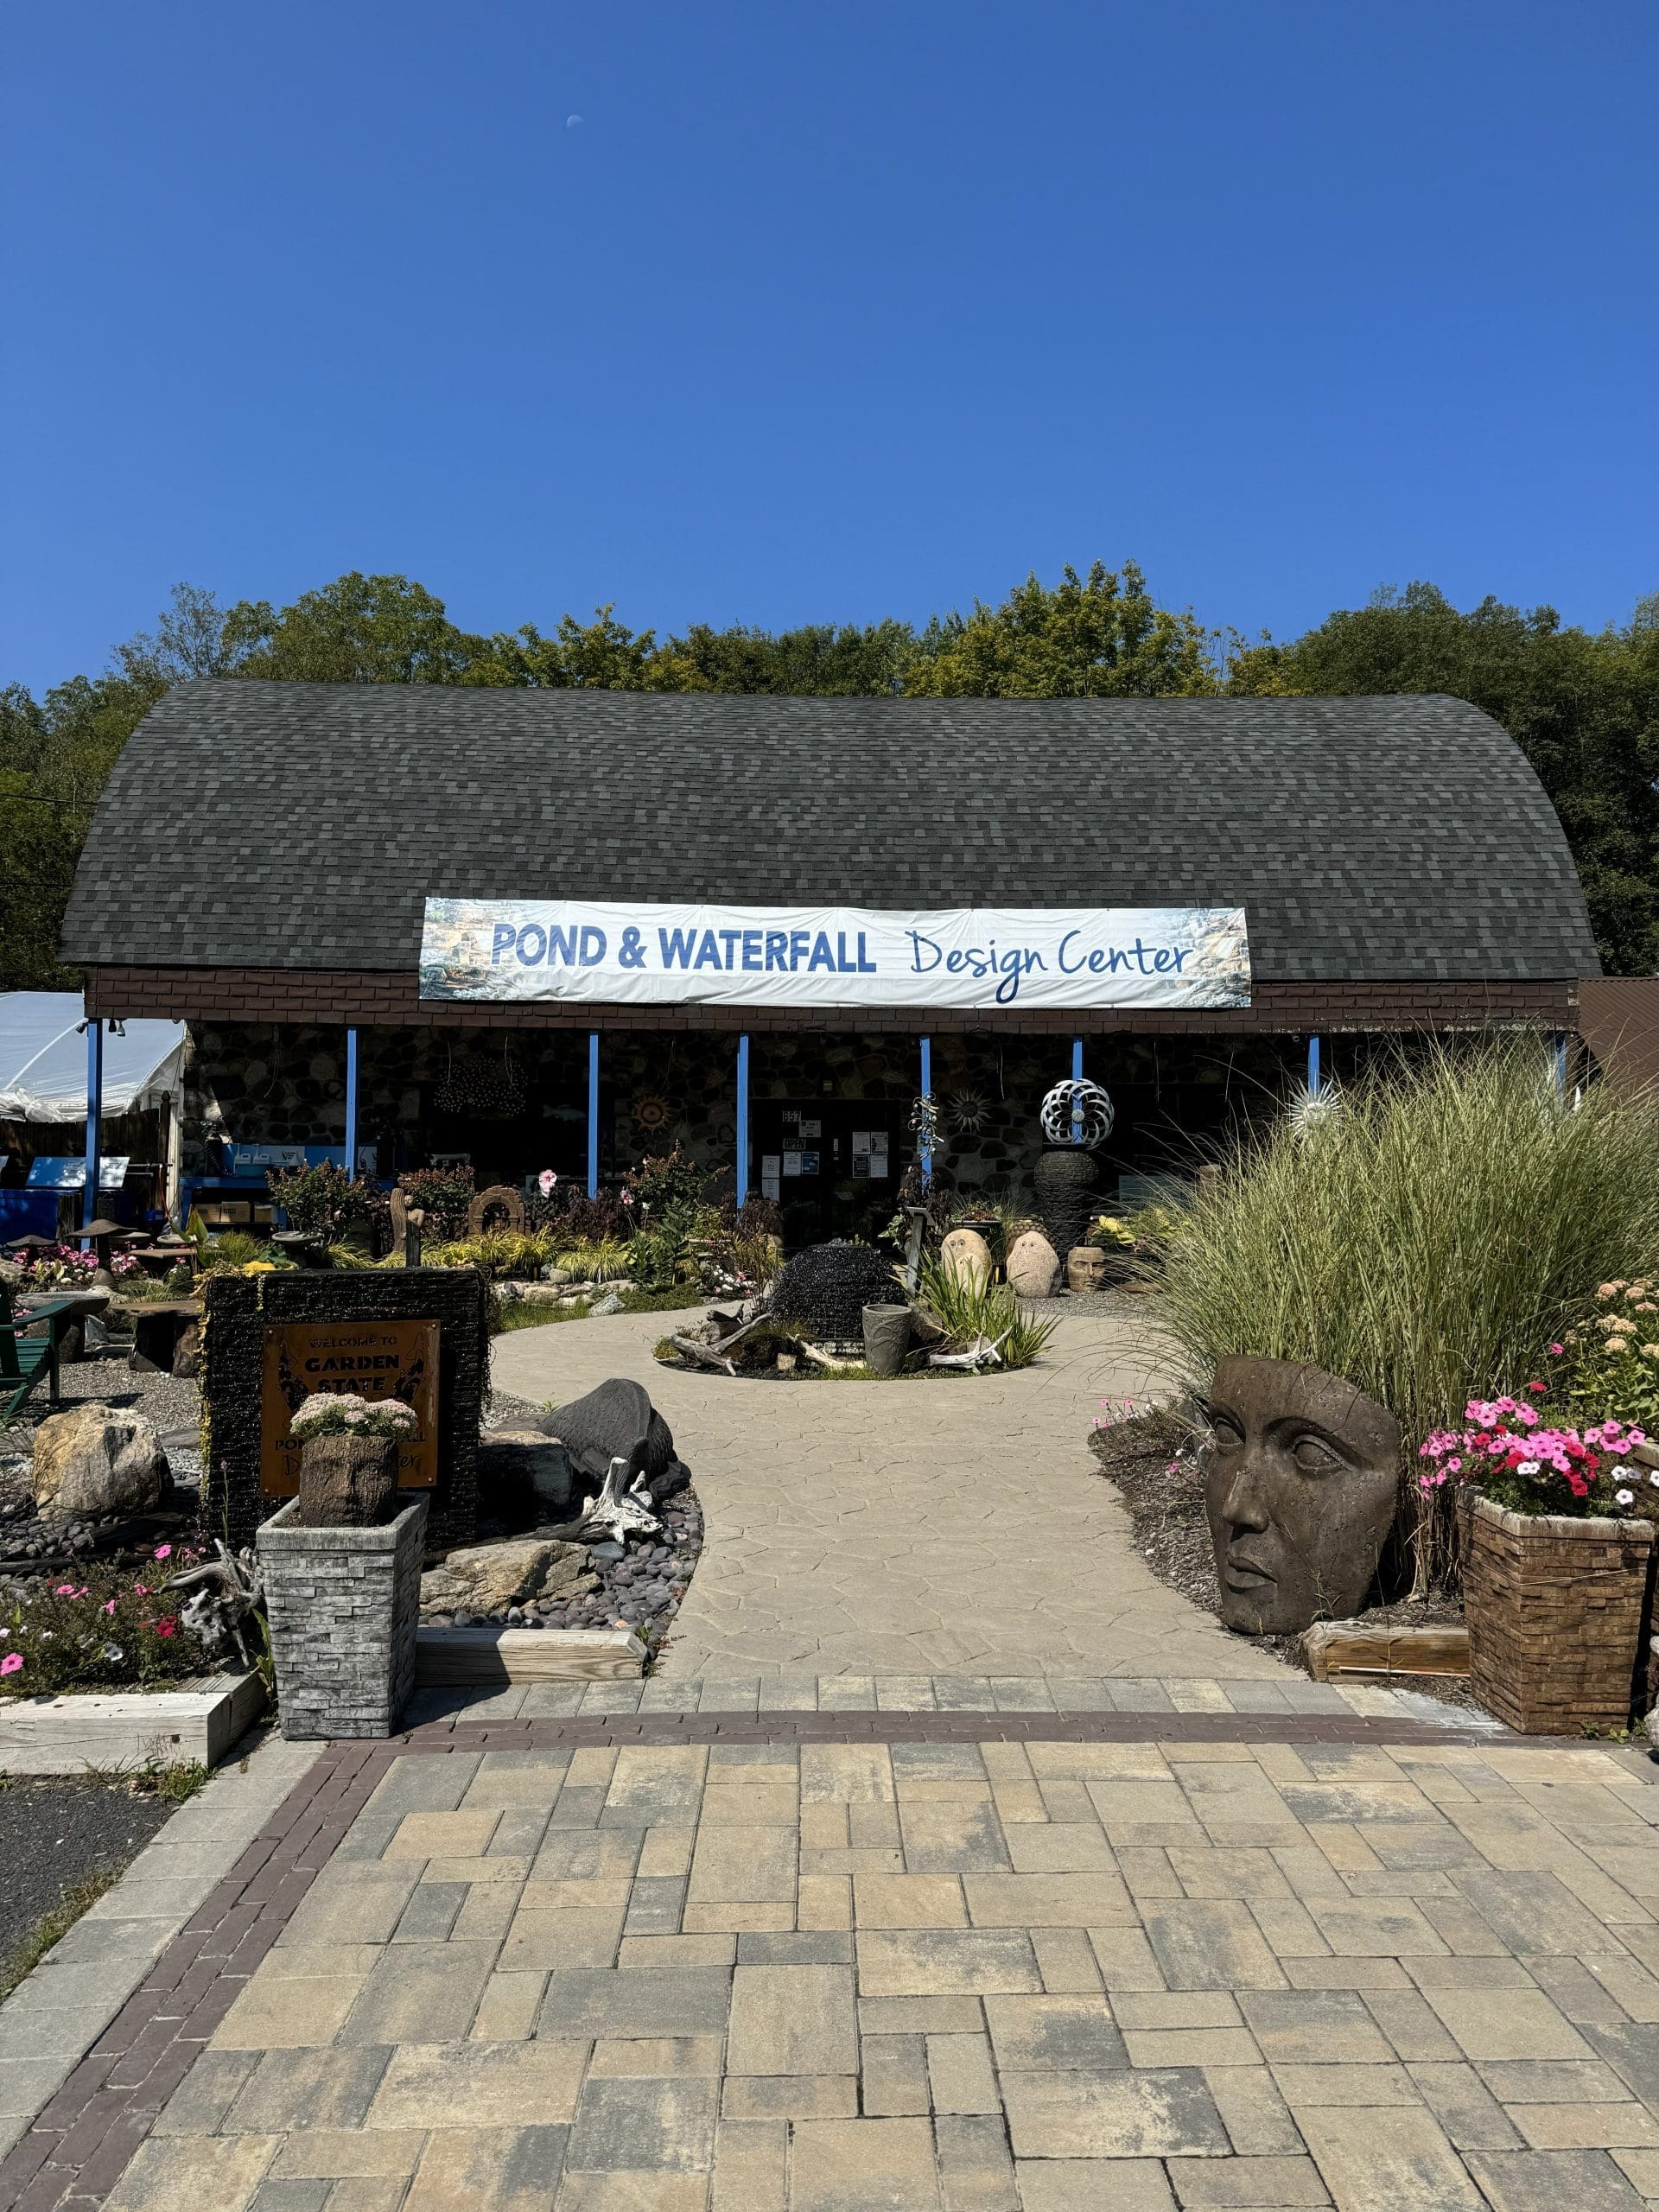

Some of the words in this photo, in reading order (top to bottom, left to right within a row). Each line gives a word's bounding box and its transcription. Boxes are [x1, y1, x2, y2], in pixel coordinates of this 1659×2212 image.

[491, 923, 606, 967] POND
[618, 925, 648, 969] &
[658, 927, 877, 973] WATERFALL
[905, 930, 1048, 1004] Design
[1058, 930, 1193, 975] Center
[785, 1139, 804, 1149] OPEN
[309, 1336, 378, 1348] WELCOME
[381, 1336, 397, 1346] TO
[304, 1355, 399, 1372] GARDEN
[317, 1376, 385, 1393] STATE
